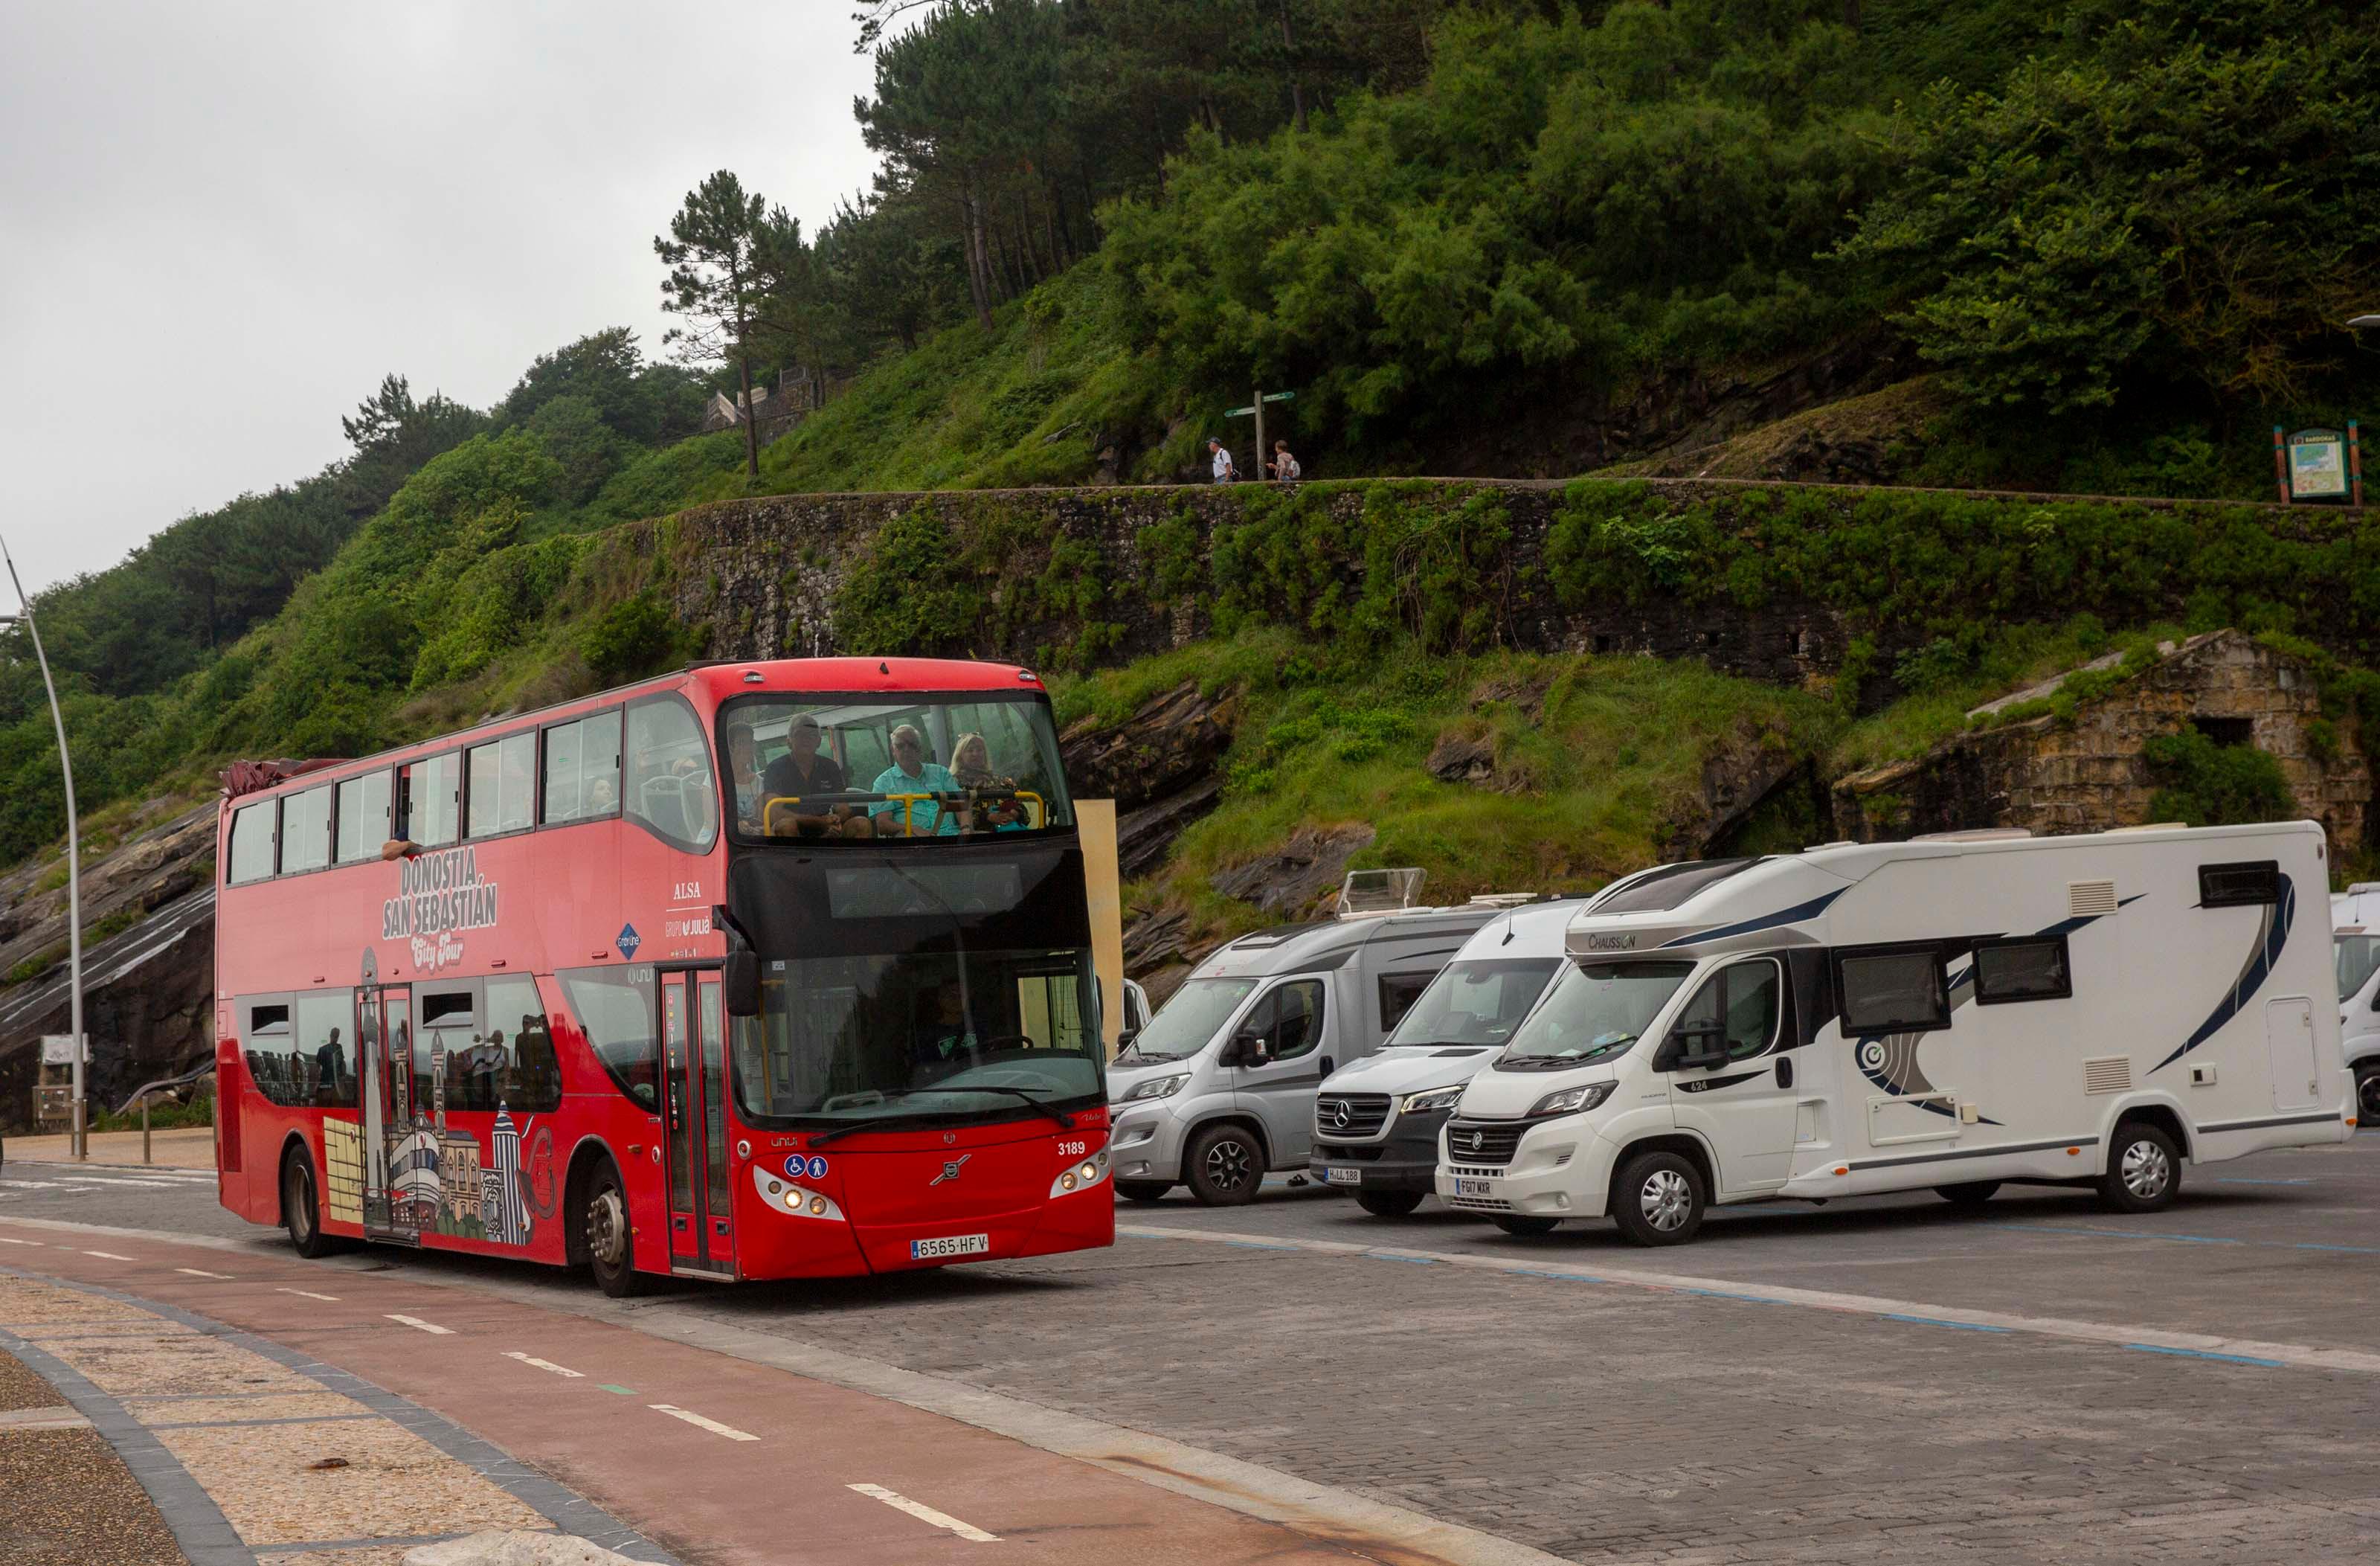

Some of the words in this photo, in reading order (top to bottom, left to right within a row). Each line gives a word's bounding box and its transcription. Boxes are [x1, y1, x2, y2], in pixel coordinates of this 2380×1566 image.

[401, 847, 477, 897] DONOSTIA
[674, 882, 701, 899] ALSA
[383, 899, 411, 938] SAN
[414, 874, 497, 933] SEBASTIÁN
[666, 921, 682, 937] GRUPO
[1589, 934, 1636, 949] CHAUSSON
[411, 937, 436, 969] City
[437, 933, 463, 965] Tour
[1691, 1081, 1708, 1091] 624
[1058, 1141, 1085, 1155] 3189
[921, 1239, 956, 1256] 6565
[960, 1236, 985, 1252] HFV
